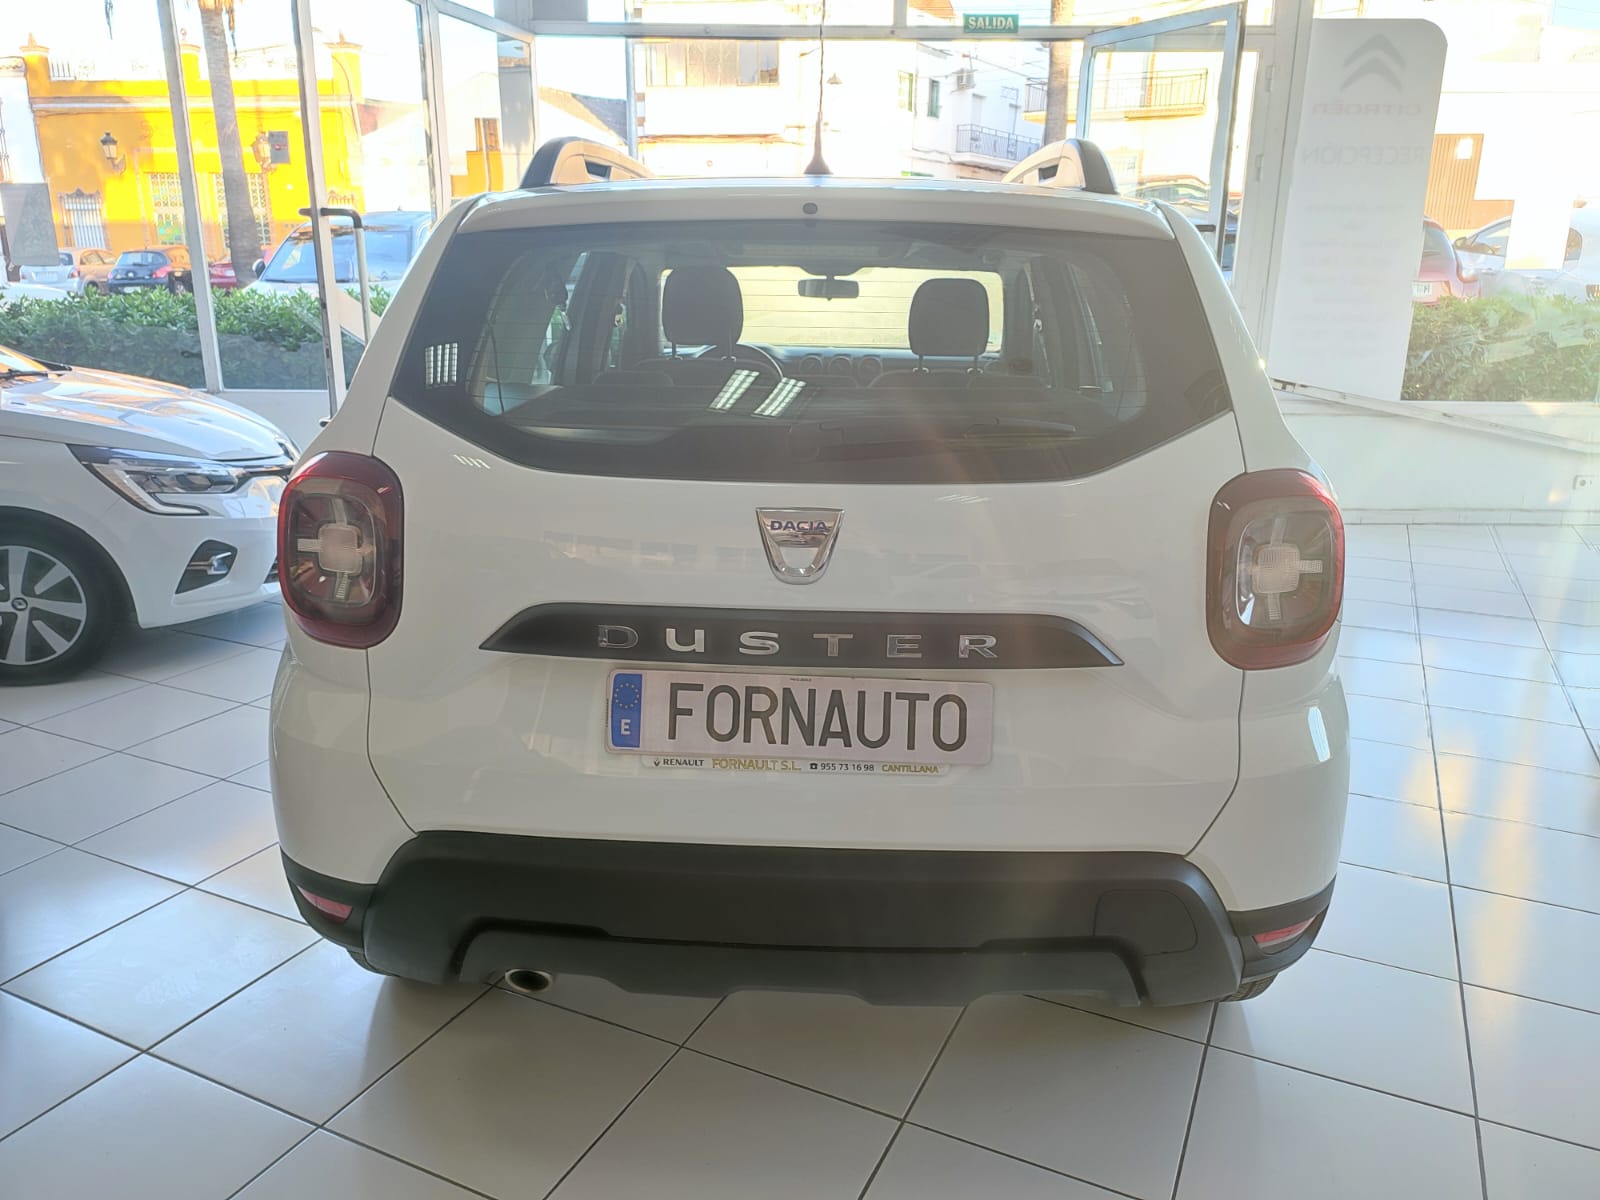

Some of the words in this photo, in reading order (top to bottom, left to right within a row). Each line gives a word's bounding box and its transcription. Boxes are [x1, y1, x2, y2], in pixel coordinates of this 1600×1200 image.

[968, 16, 1014, 30] SALIDA
[770, 520, 829, 532] DACIA
[597, 624, 999, 659] DUSTER
[667, 681, 968, 752] FORNAUTO
[620, 718, 631, 736] E
[663, 758, 704, 767] RENAULT
[712, 758, 778, 770] FORNAULT
[780, 760, 802, 771] S.L.
[820, 762, 836, 770] 955
[839, 763, 849, 771] 73
[852, 763, 862, 771] 16
[863, 763, 875, 772] 98
[881, 764, 939, 773] CANTILLANA
